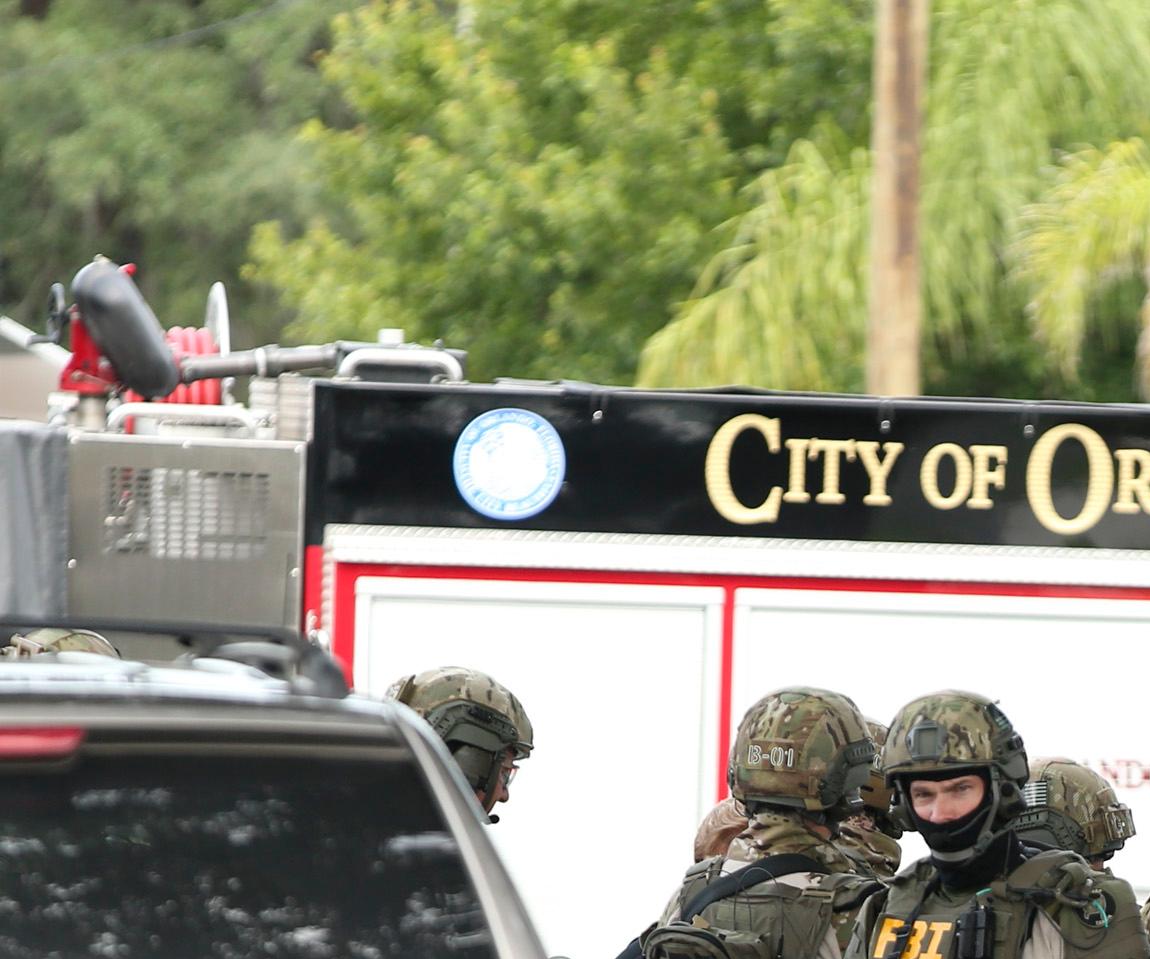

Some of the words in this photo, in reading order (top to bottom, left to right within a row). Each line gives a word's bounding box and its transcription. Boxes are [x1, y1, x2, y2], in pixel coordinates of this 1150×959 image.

[704, 412, 905, 525] CITY
[920, 442, 1008, 510] OF
[747, 744, 794, 768] B-01
